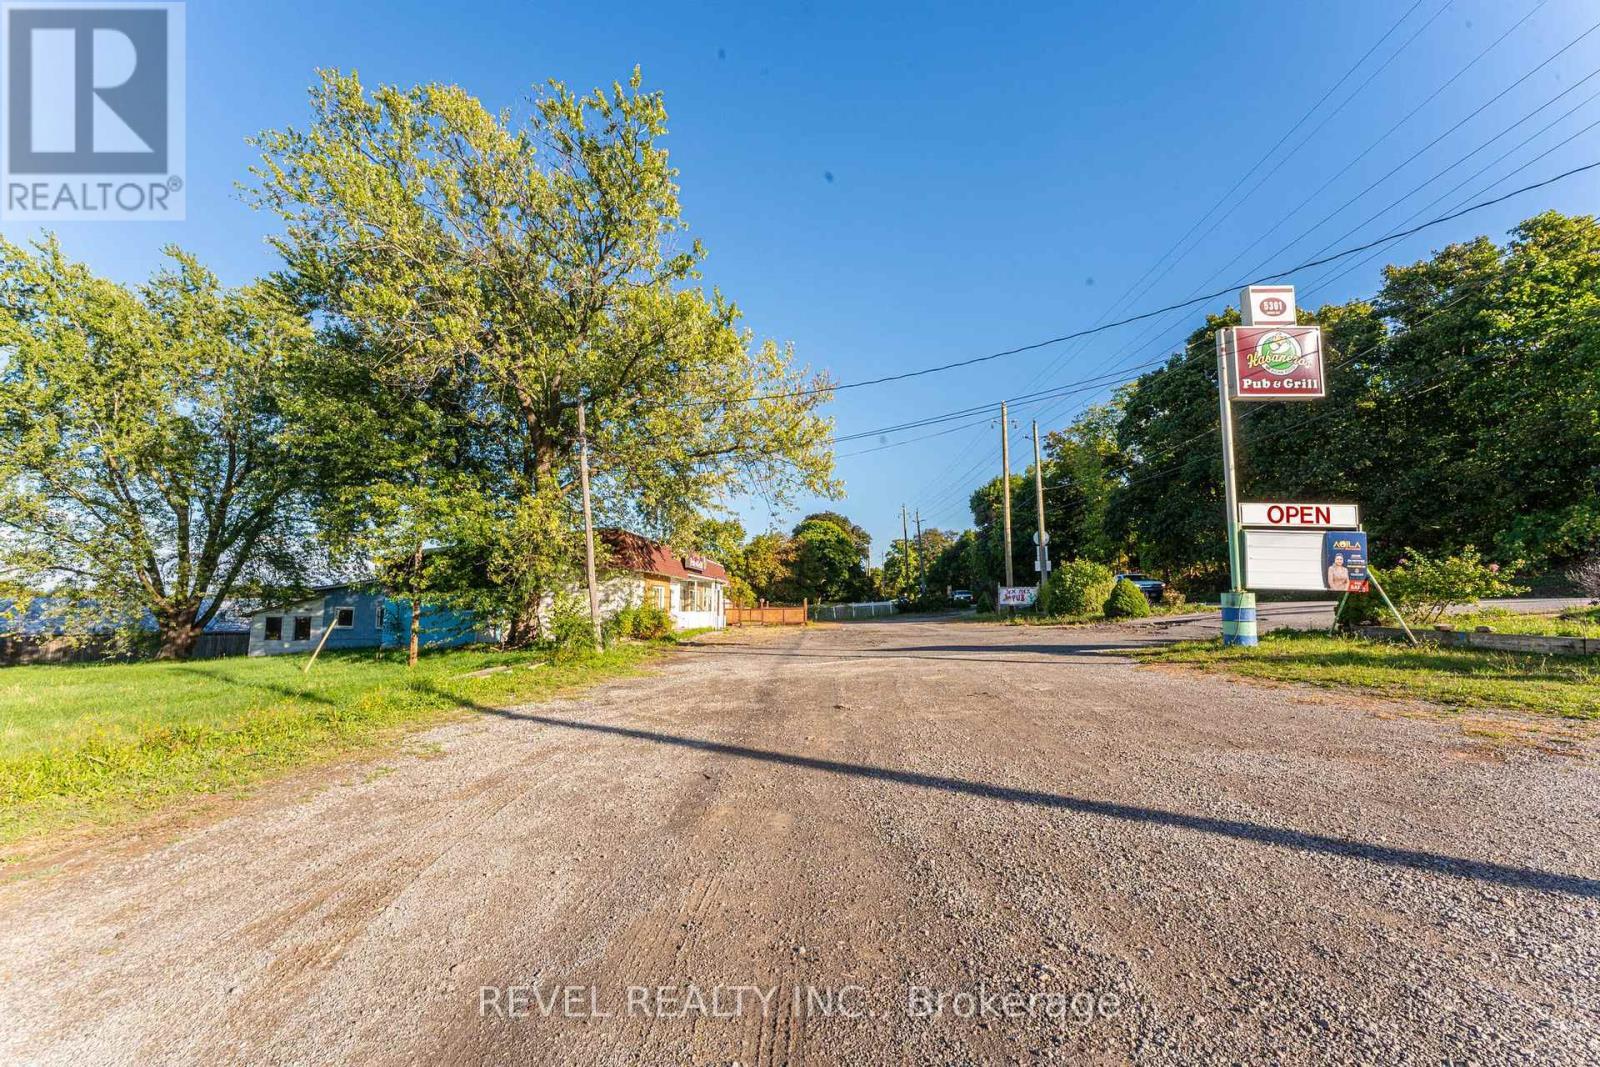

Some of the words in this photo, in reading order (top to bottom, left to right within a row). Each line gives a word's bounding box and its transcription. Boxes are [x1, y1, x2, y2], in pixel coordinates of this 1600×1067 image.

[1243, 378, 1271, 389] Pub
[1273, 380, 1281, 389] &
[1283, 378, 1318, 389] Grill
[1266, 505, 1331, 524] OPEN
